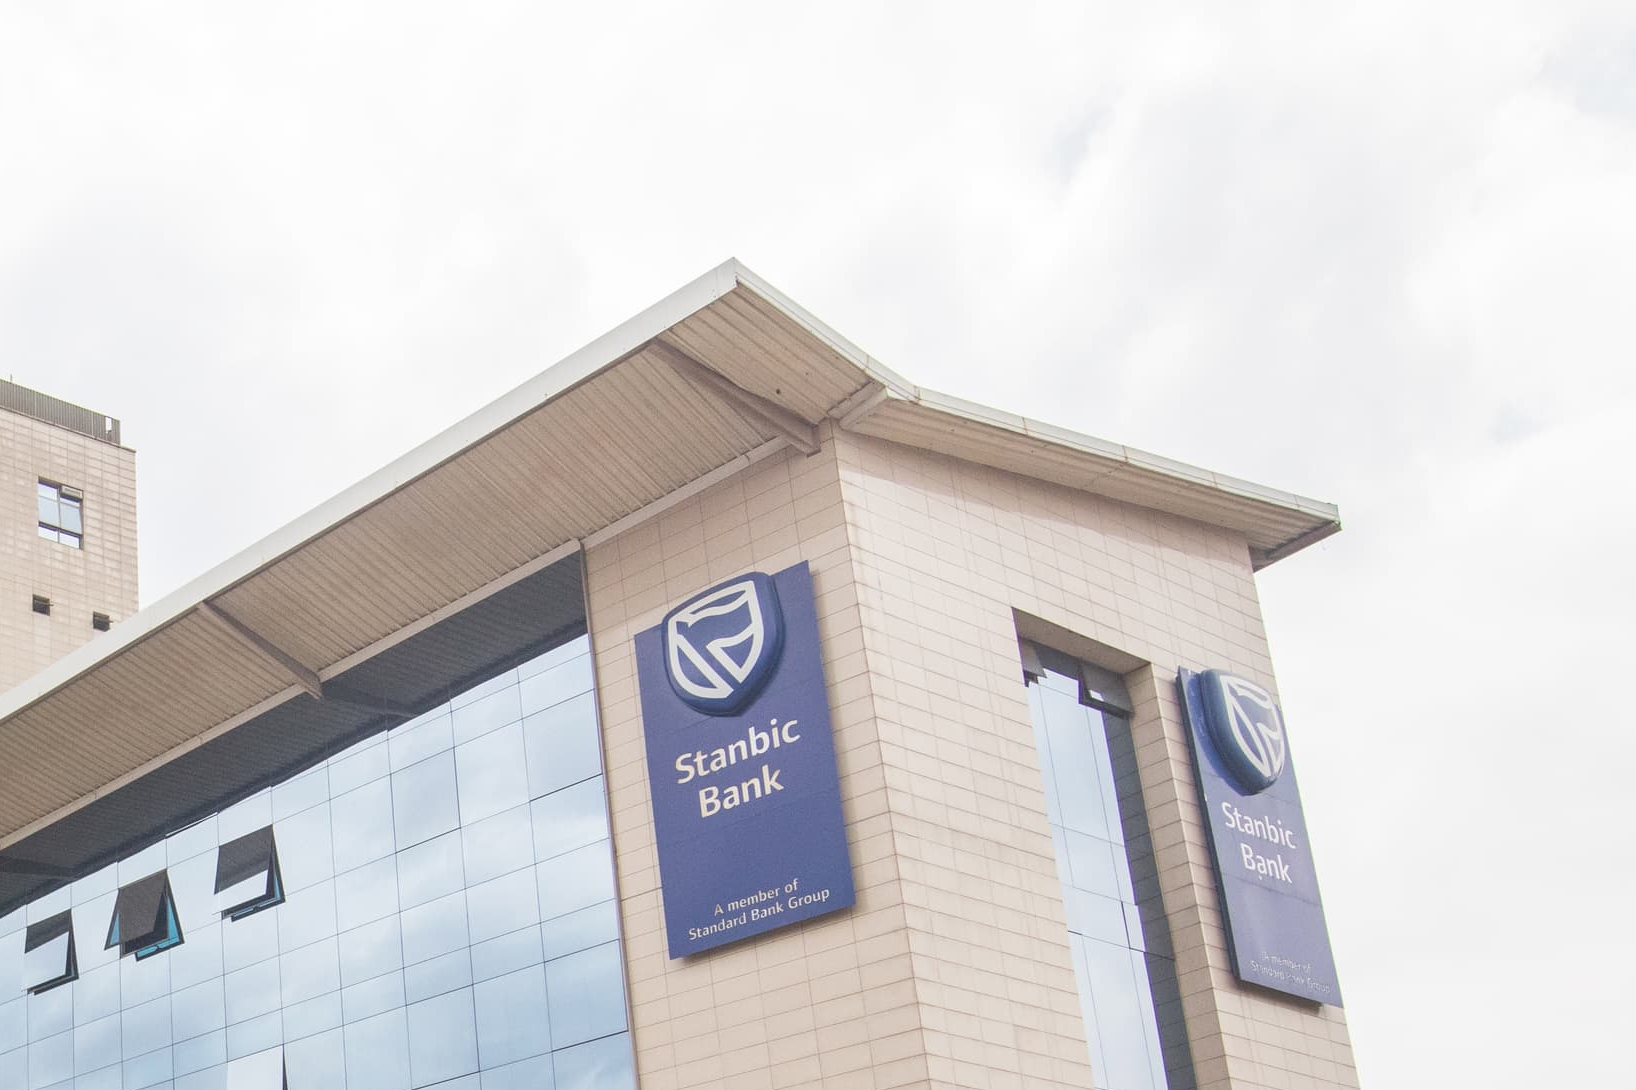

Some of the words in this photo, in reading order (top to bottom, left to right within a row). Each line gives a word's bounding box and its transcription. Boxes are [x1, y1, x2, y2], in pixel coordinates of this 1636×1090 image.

[675, 718, 801, 784] Stanbic
[698, 764, 785, 818] Bank
[1221, 801, 1297, 849] Stanbic
[1240, 843, 1293, 884] Bank
[688, 914, 747, 941] Standard
[750, 902, 784, 921] Bank
[788, 888, 830, 909] Group
[714, 903, 724, 916] A
[727, 887, 780, 912] member
[784, 878, 799, 894] of
